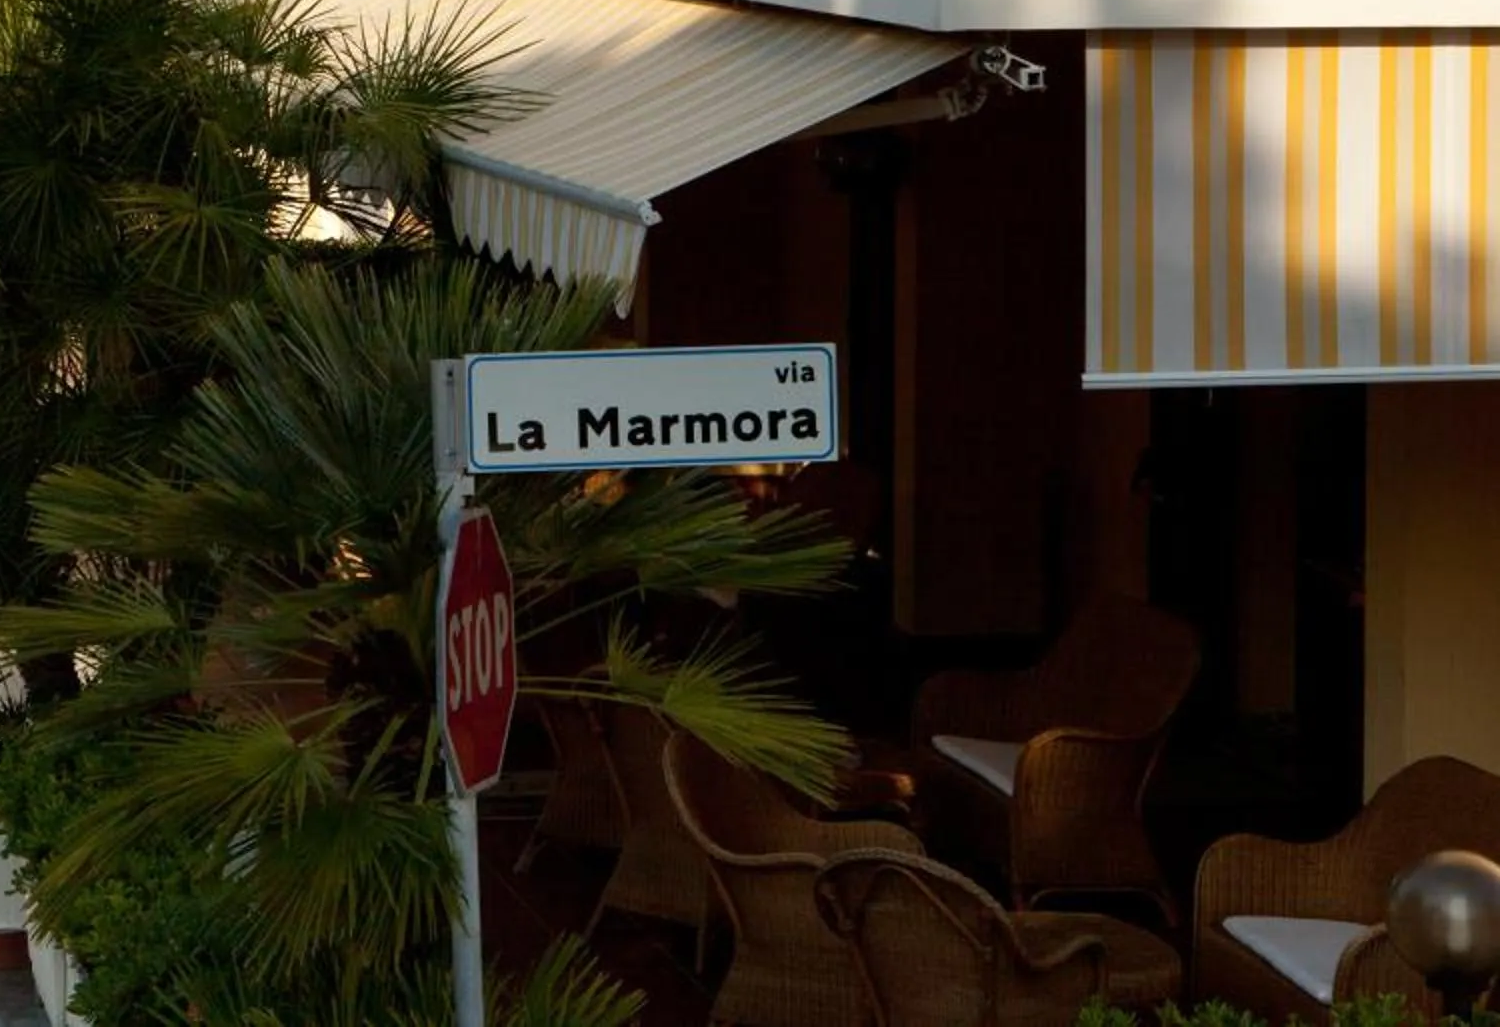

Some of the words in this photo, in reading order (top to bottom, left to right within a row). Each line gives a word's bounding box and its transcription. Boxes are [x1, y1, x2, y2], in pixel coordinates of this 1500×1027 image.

[775, 361, 816, 384] via
[487, 411, 546, 453] La
[578, 406, 820, 449] Marmora
[449, 592, 509, 711] STOP
